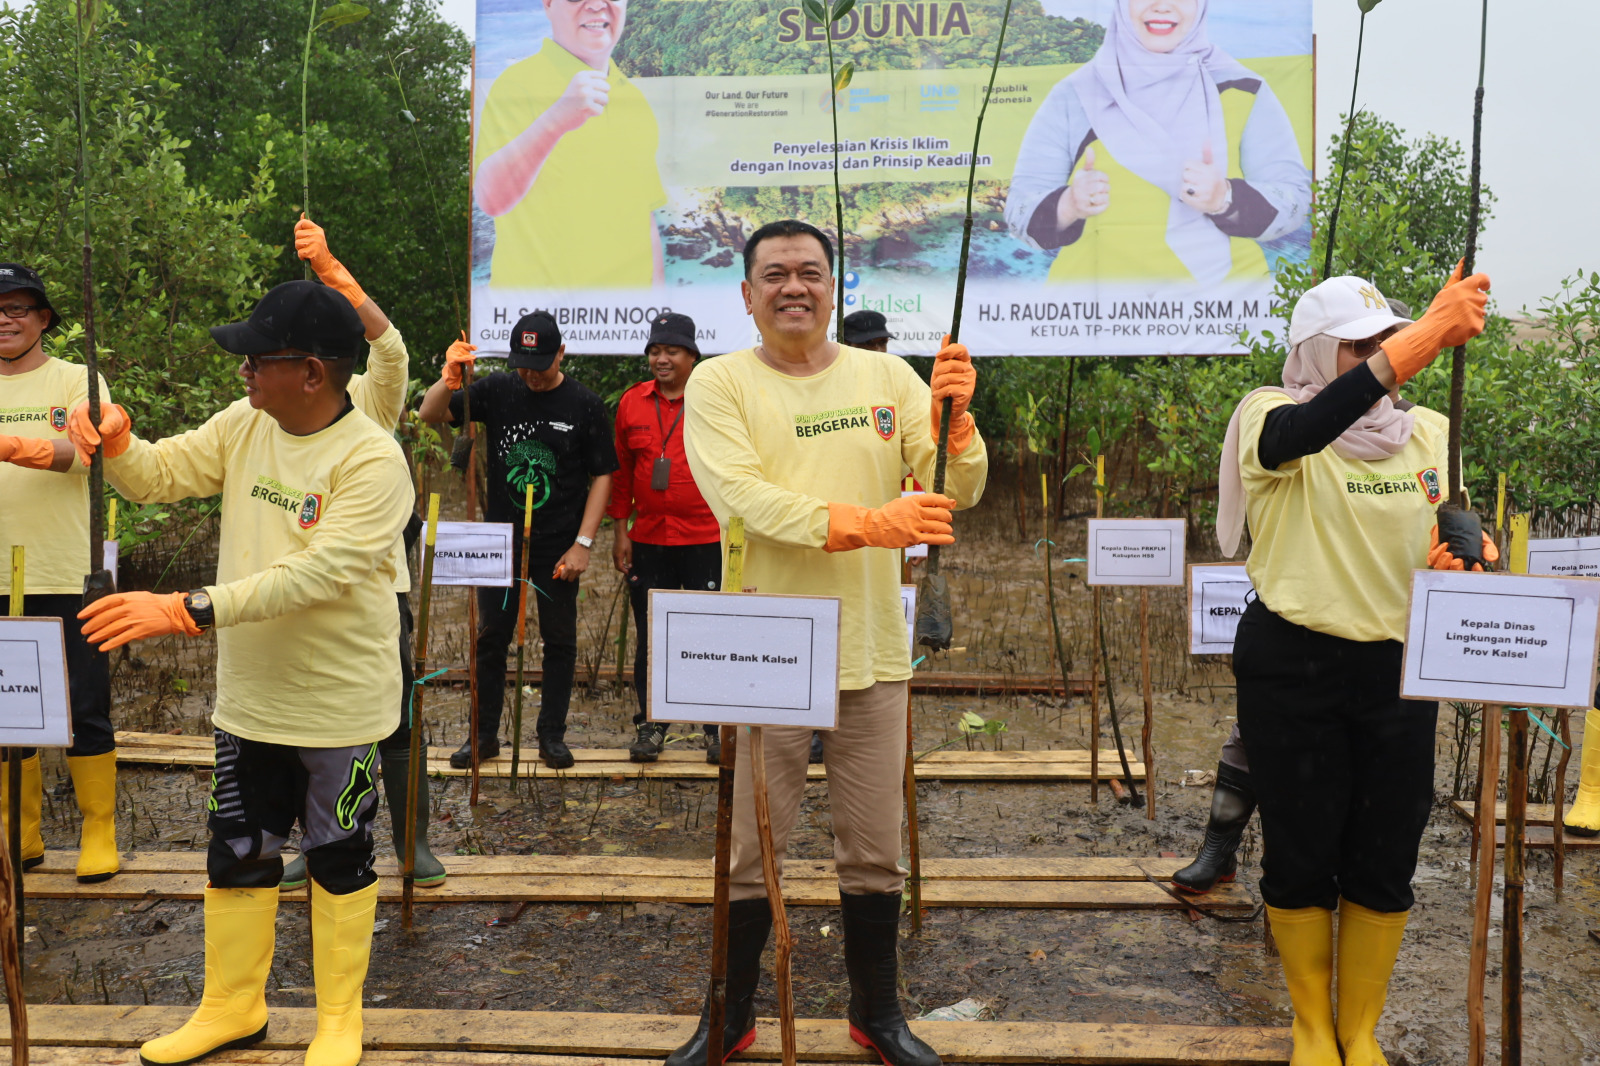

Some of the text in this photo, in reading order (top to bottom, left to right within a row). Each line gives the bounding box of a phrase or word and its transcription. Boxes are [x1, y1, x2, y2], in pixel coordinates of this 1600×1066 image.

[778, 2, 972, 43] SEDUNIA
[705, 91, 720, 99] Our
[745, 91, 760, 99] Our
[762, 91, 789, 99] Future
[920, 84, 944, 98] UN
[982, 84, 1029, 94] Republik
[734, 101, 746, 109] We
[982, 95, 1033, 104] Indonesia
[705, 109, 788, 117] #GenerationRestoration
[773, 137, 949, 157] Penyelesaian Krisis Iklim
[730, 153, 991, 175] dengan Inovas dan Prinsip Keadilan
[861, 293, 922, 313] kalsel
[493, 307, 512, 325] H.
[979, 304, 1005, 321] HJ.
[1010, 302, 1104, 321] RAUDATUL
[903, 331, 925, 341] JULI
[1031, 324, 1079, 337] KETUA
[1084, 323, 1142, 337] TP-PKK
[1147, 323, 1190, 336] PROV
[0, 412, 48, 424] ERGERAK
[795, 415, 870, 437] BERGERAK
[1346, 481, 1419, 495] BERGERAK
[464, 551, 489, 559] BALAI
[489, 552, 503, 560] PPI
[1551, 564, 1578, 572] Kepala
[1209, 606, 1243, 617] KEPAL
[1460, 618, 1536, 631] Kepala Dinas
[1445, 632, 1548, 648] Lingkungan Hidup
[680, 650, 798, 664] Direktur Bank Kalsel
[1463, 647, 1528, 659] Prov Kalsel
[0, 684, 39, 693] LATAN
